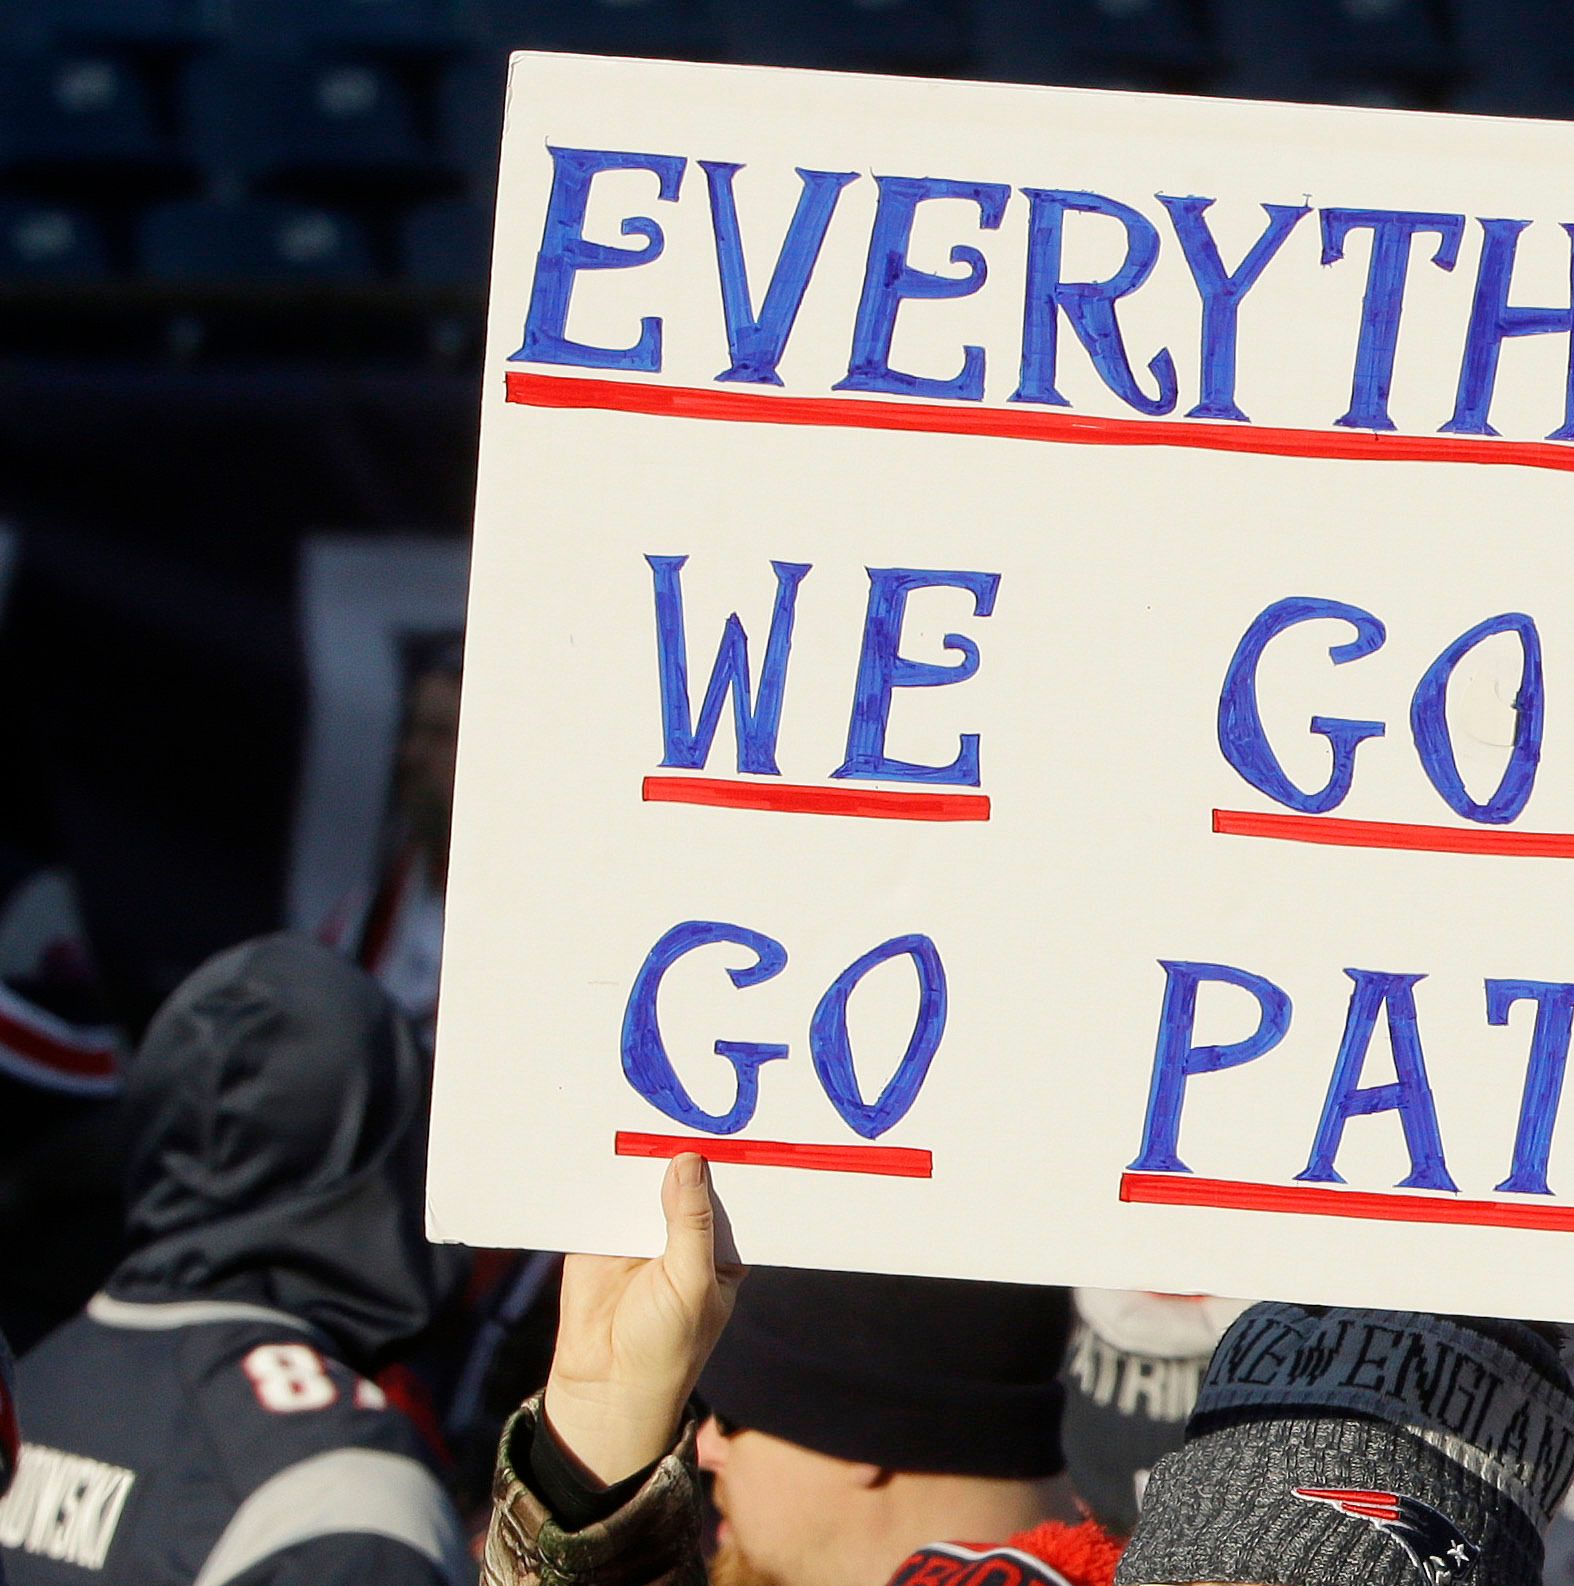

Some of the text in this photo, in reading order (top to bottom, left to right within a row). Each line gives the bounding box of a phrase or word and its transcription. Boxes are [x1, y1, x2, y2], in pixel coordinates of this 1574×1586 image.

[644, 554, 1001, 786] WE
[620, 920, 948, 1138] GO
[1209, 1317, 1348, 1388] NEW
